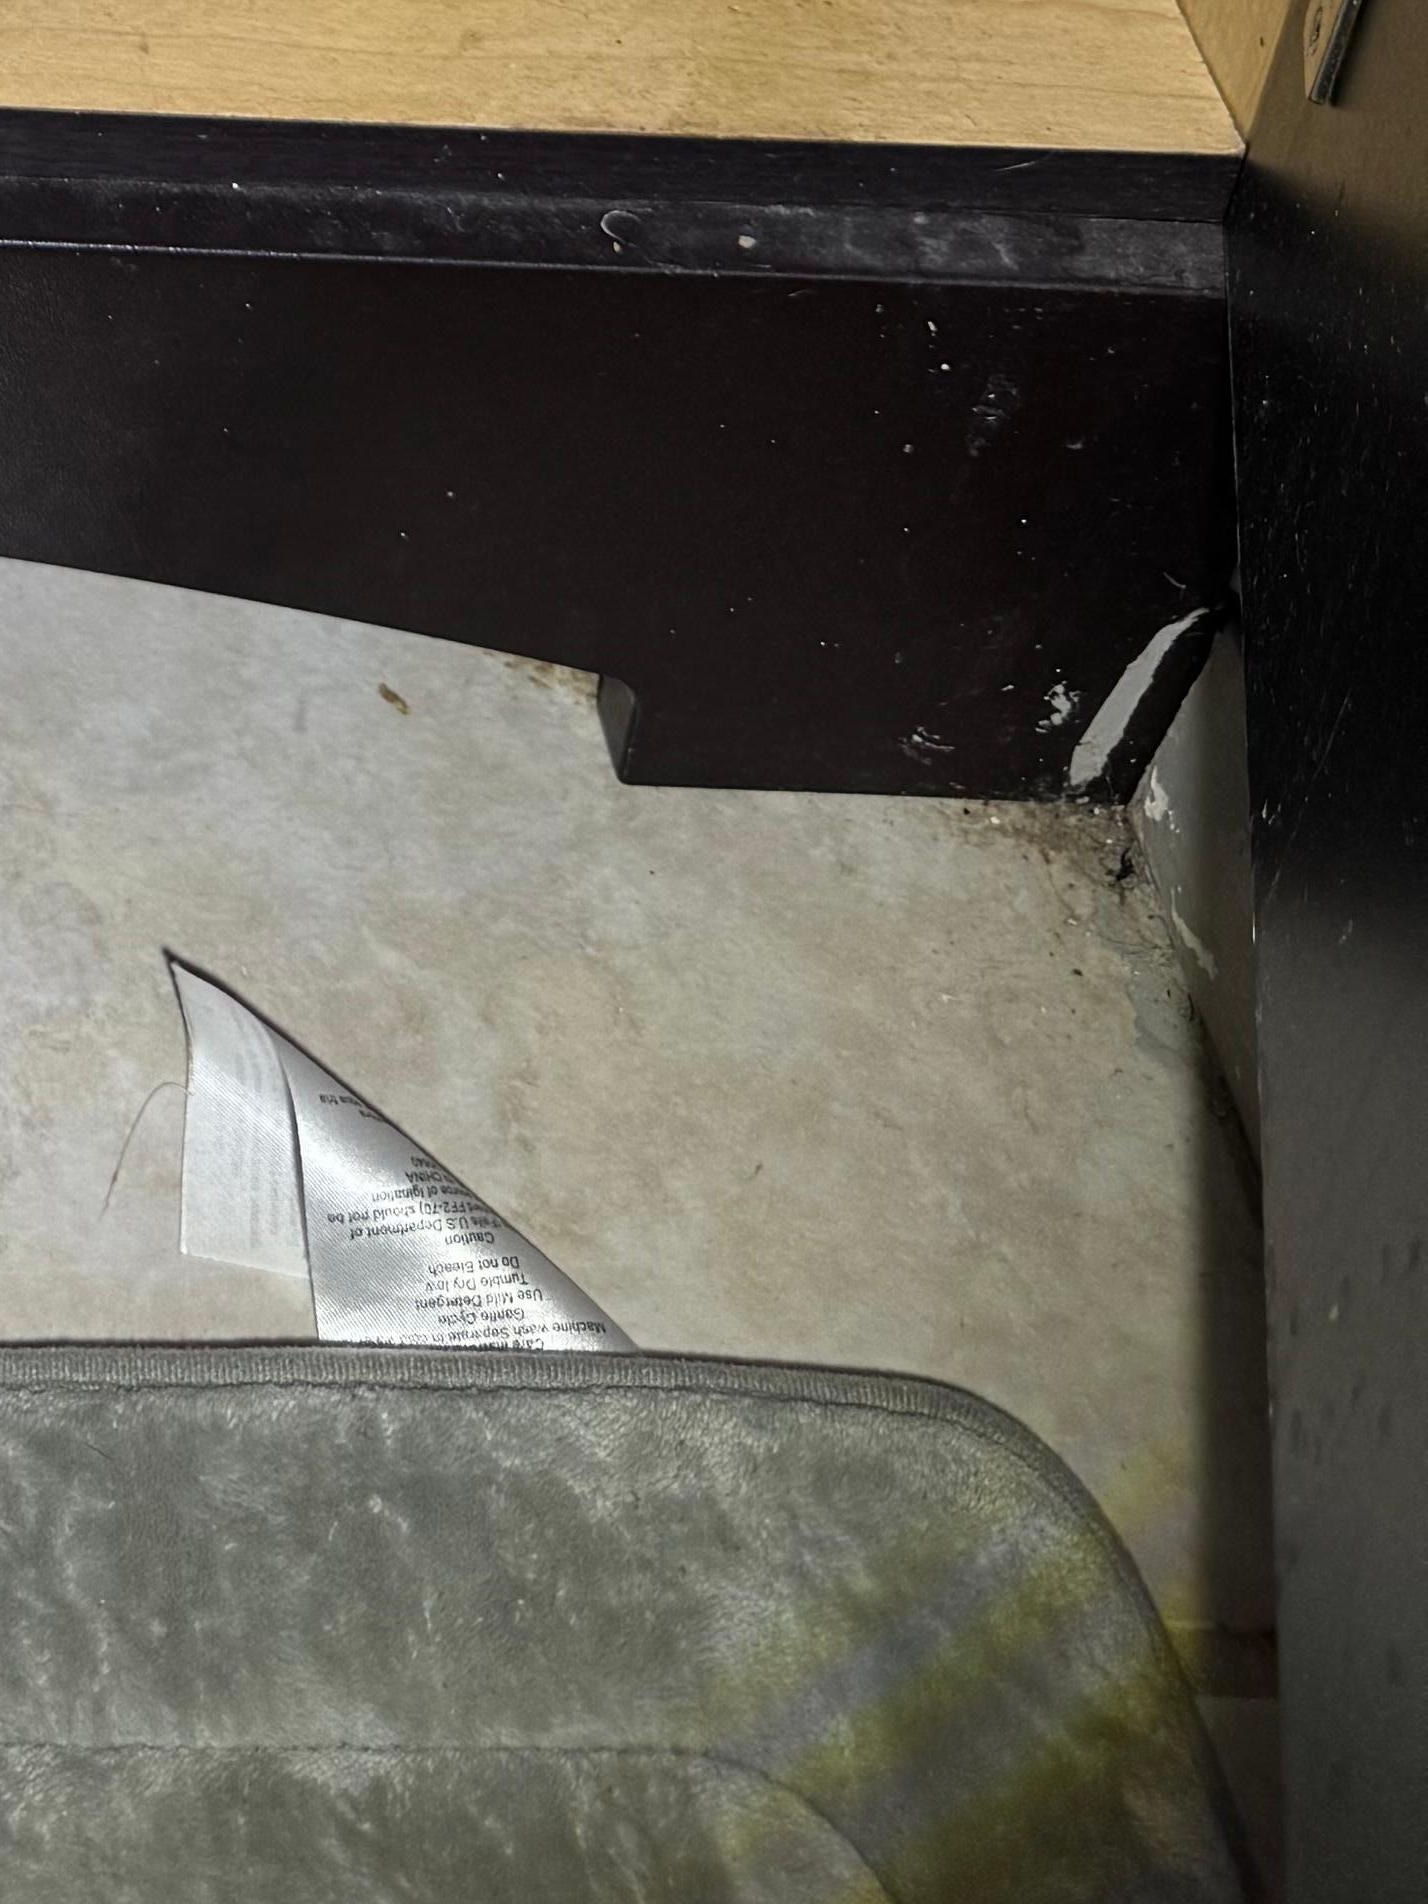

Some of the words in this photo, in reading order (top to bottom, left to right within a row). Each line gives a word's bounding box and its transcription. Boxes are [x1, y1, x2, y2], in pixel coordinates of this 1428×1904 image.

[445, 1232, 495, 1245] Caution
[478, 1257, 499, 1270] not
[501, 1256, 520, 1269] Do
[453, 1276, 477, 1292] Dry
[480, 1273, 529, 1287] Tumble
[517, 1289, 543, 1301] Use
[553, 1322, 606, 1335] Machine
